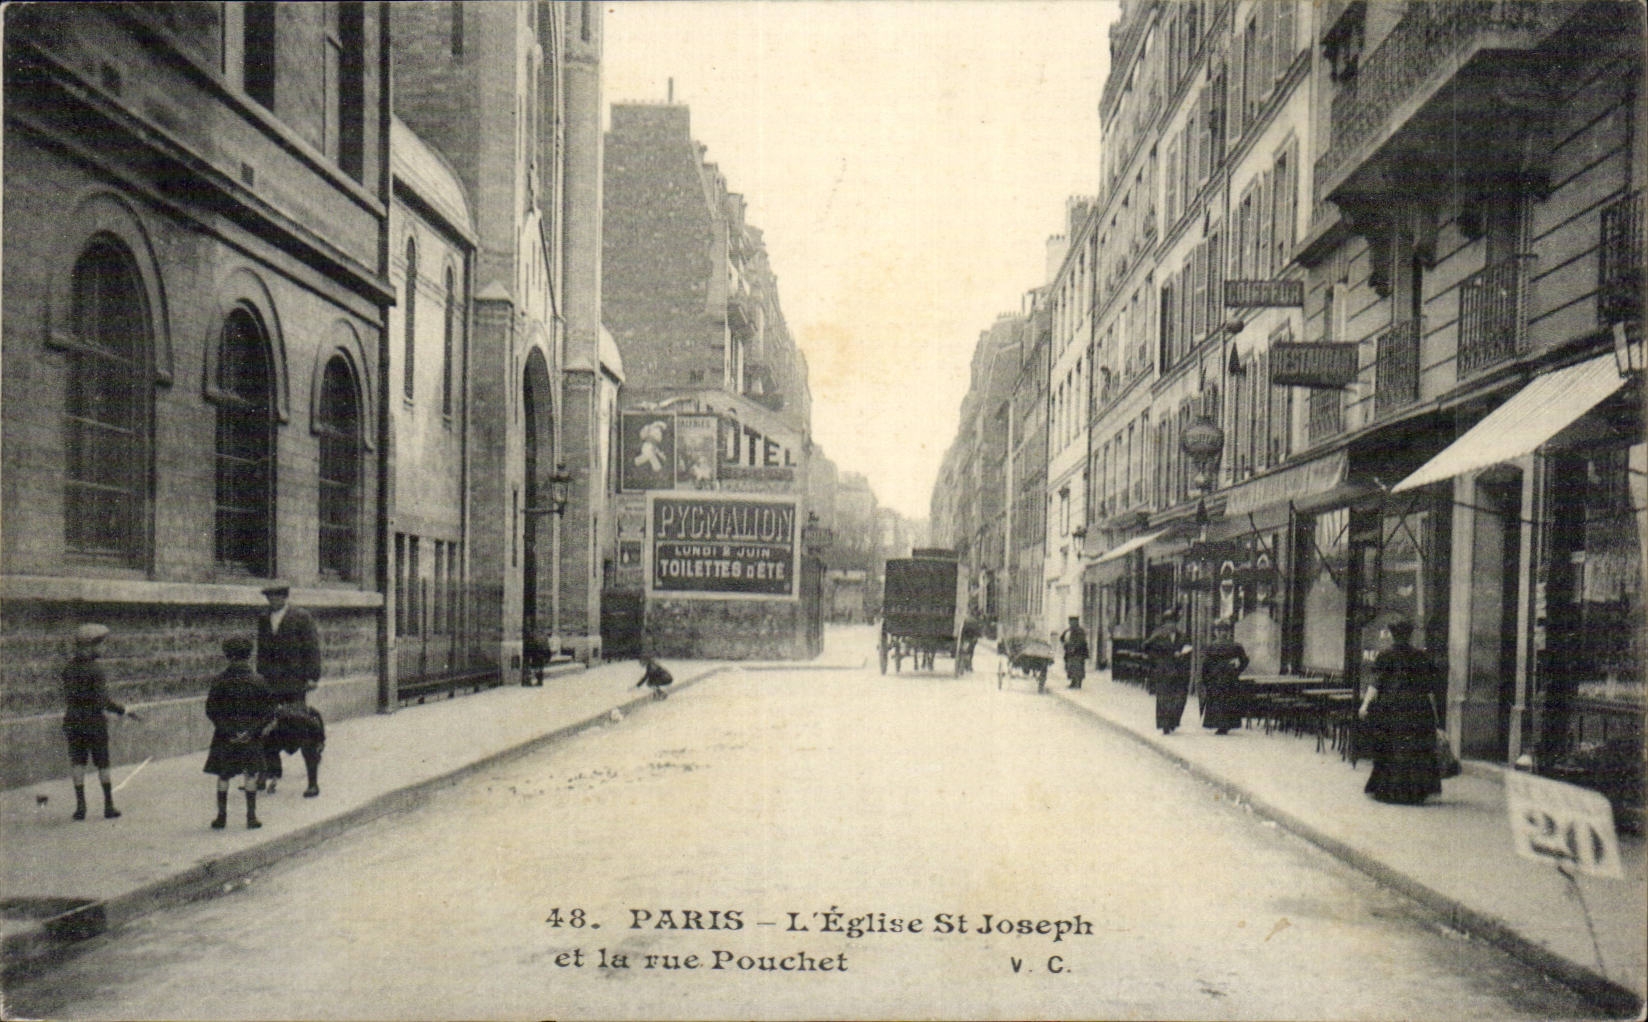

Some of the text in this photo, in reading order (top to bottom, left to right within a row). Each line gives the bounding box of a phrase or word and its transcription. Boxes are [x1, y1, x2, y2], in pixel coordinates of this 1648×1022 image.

[656, 504, 794, 542] PYGMALION
[674, 545, 717, 557] LUNDI
[736, 547, 771, 559] JUIN
[660, 558, 741, 578] TOILETTES
